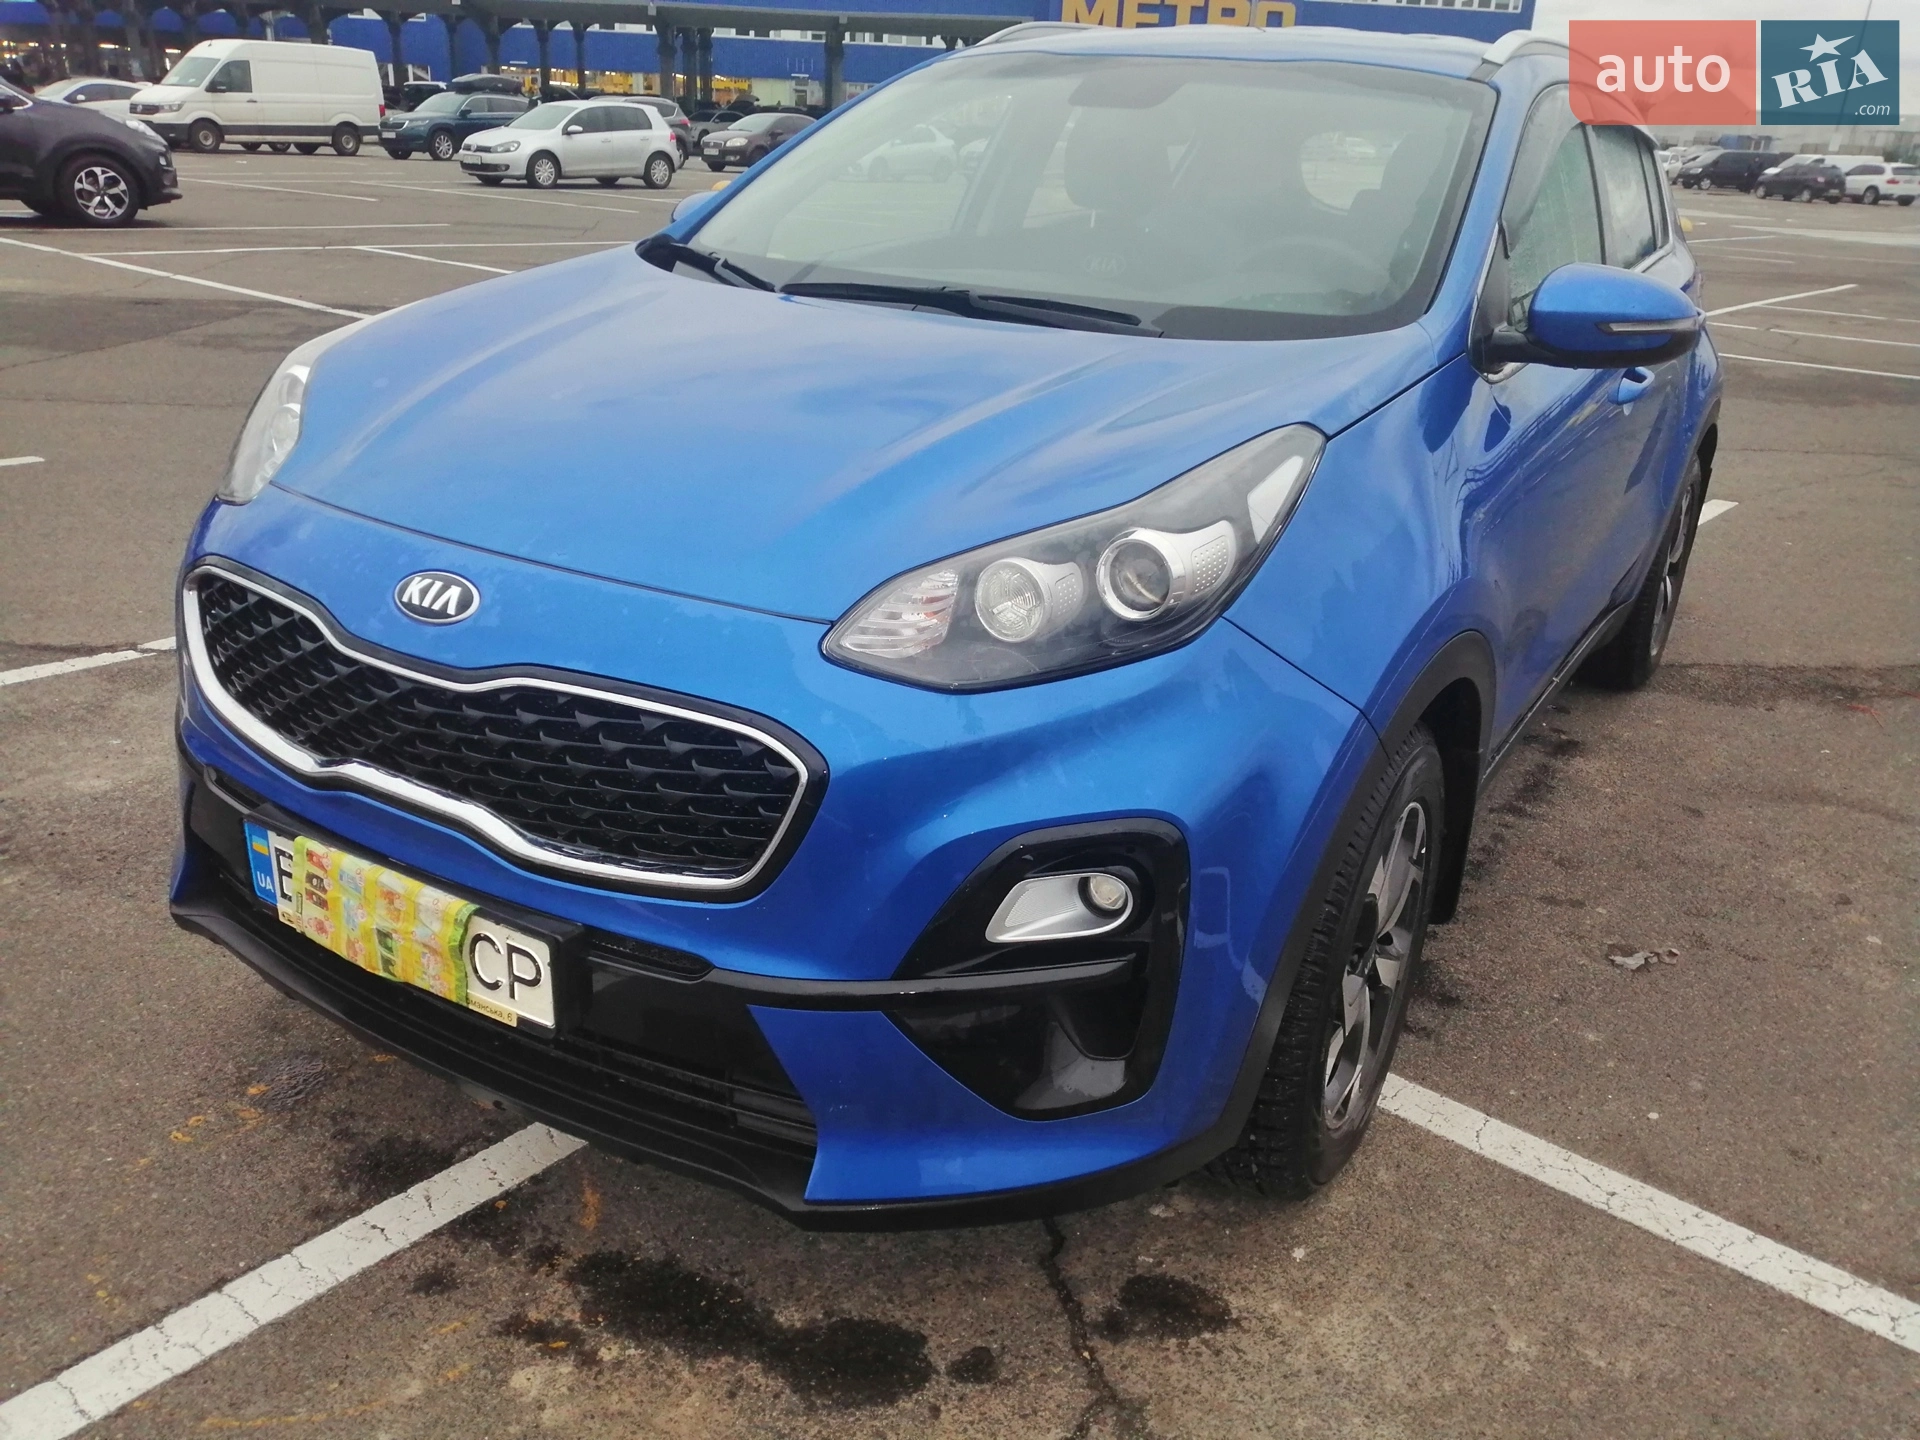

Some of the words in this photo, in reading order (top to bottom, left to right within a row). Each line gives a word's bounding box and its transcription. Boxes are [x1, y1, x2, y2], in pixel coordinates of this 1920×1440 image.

[1061, 0, 1297, 28] METRO
[401, 576, 462, 616] KIA
[256, 870, 275, 894] UA
[469, 932, 545, 1001] CP
[507, 1012, 513, 1022] 6
